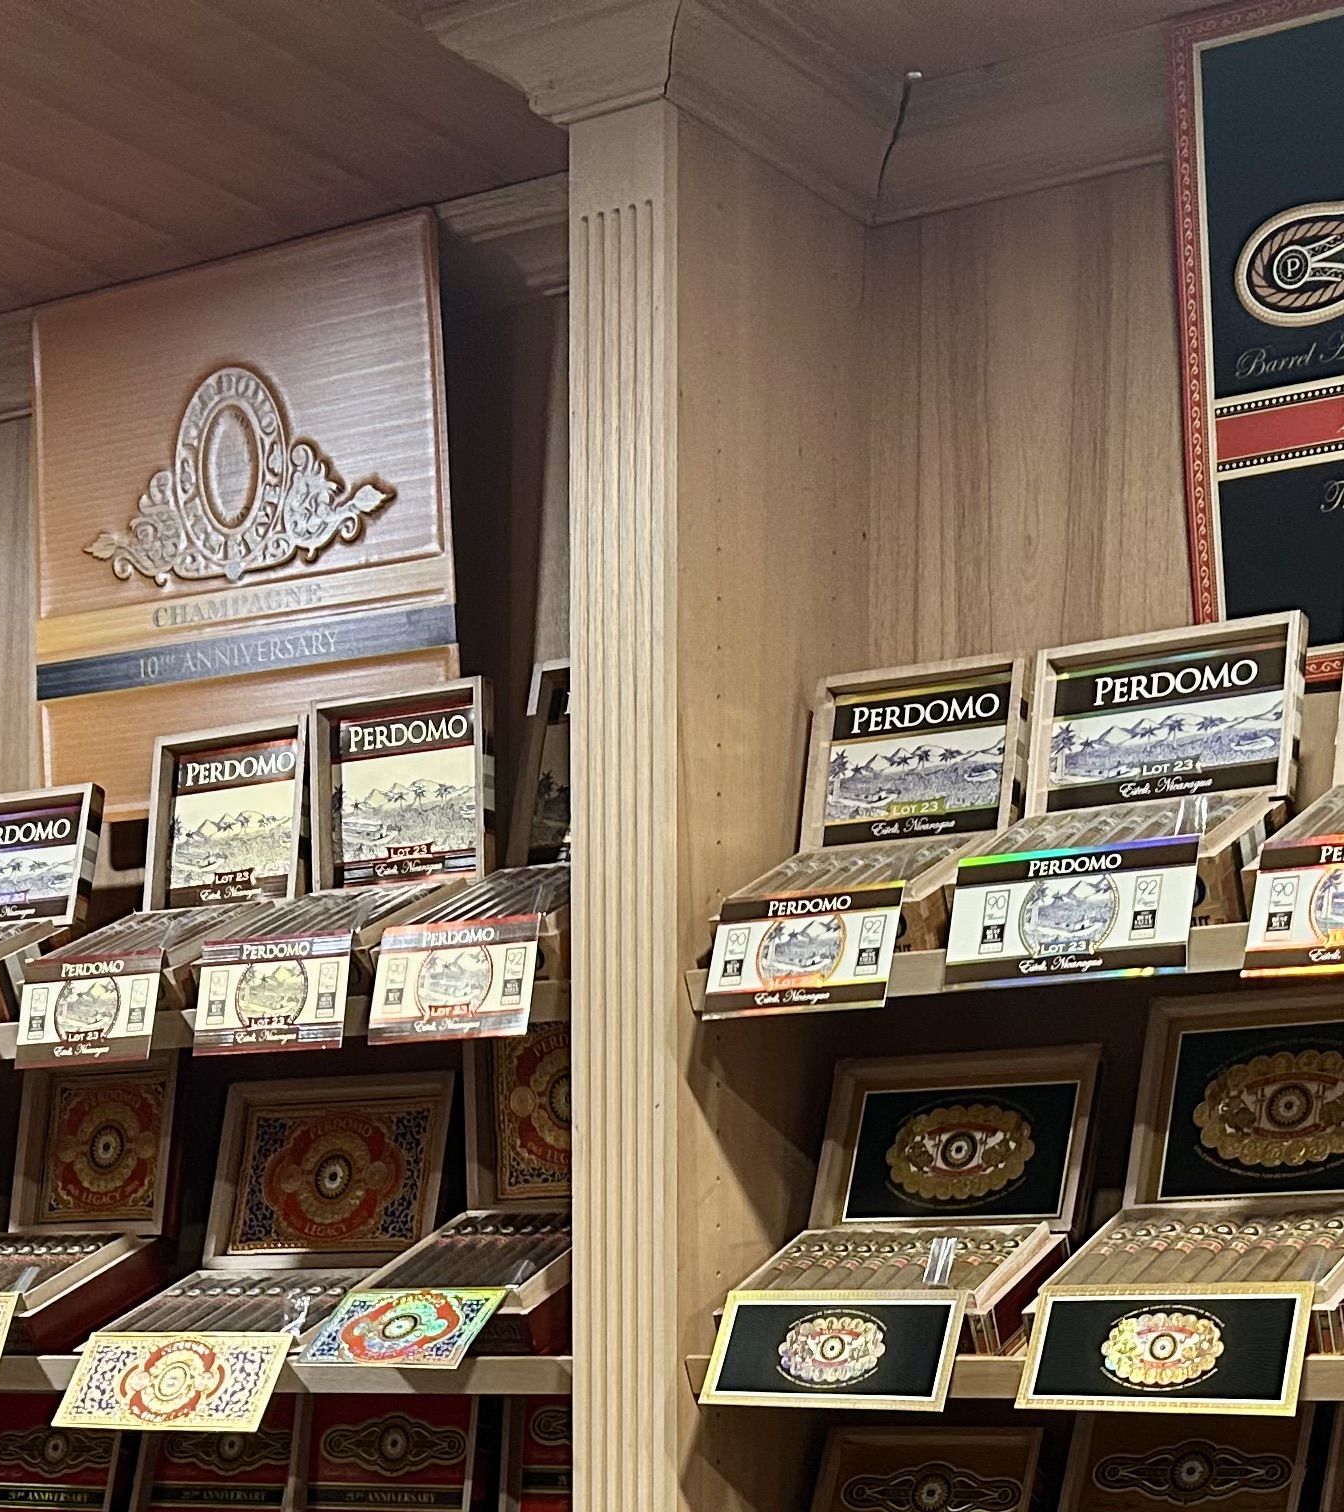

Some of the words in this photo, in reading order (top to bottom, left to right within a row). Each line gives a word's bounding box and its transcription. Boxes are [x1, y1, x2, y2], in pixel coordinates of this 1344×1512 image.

[1284, 257, 1301, 278] P
[1235, 346, 1314, 378] Barrel
[151, 582, 323, 629] CHAMPAGNE
[181, 629, 341, 673] ANNIVERSARY
[1093, 658, 1259, 707] PERDOMO
[851, 692, 1000, 734] PERDOMO
[348, 714, 468, 753] PERDOMO
[185, 751, 295, 787] PERDOMO
[1142, 761, 1171, 777] LOT
[1173, 757, 1194, 773] 23
[1028, 851, 1122, 878] PERDOMO
[767, 894, 852, 918] PERDOMO
[242, 941, 310, 961] PERDOMO
[421, 926, 495, 948] PERDOMO
[60, 960, 124, 978] PERDOMO
